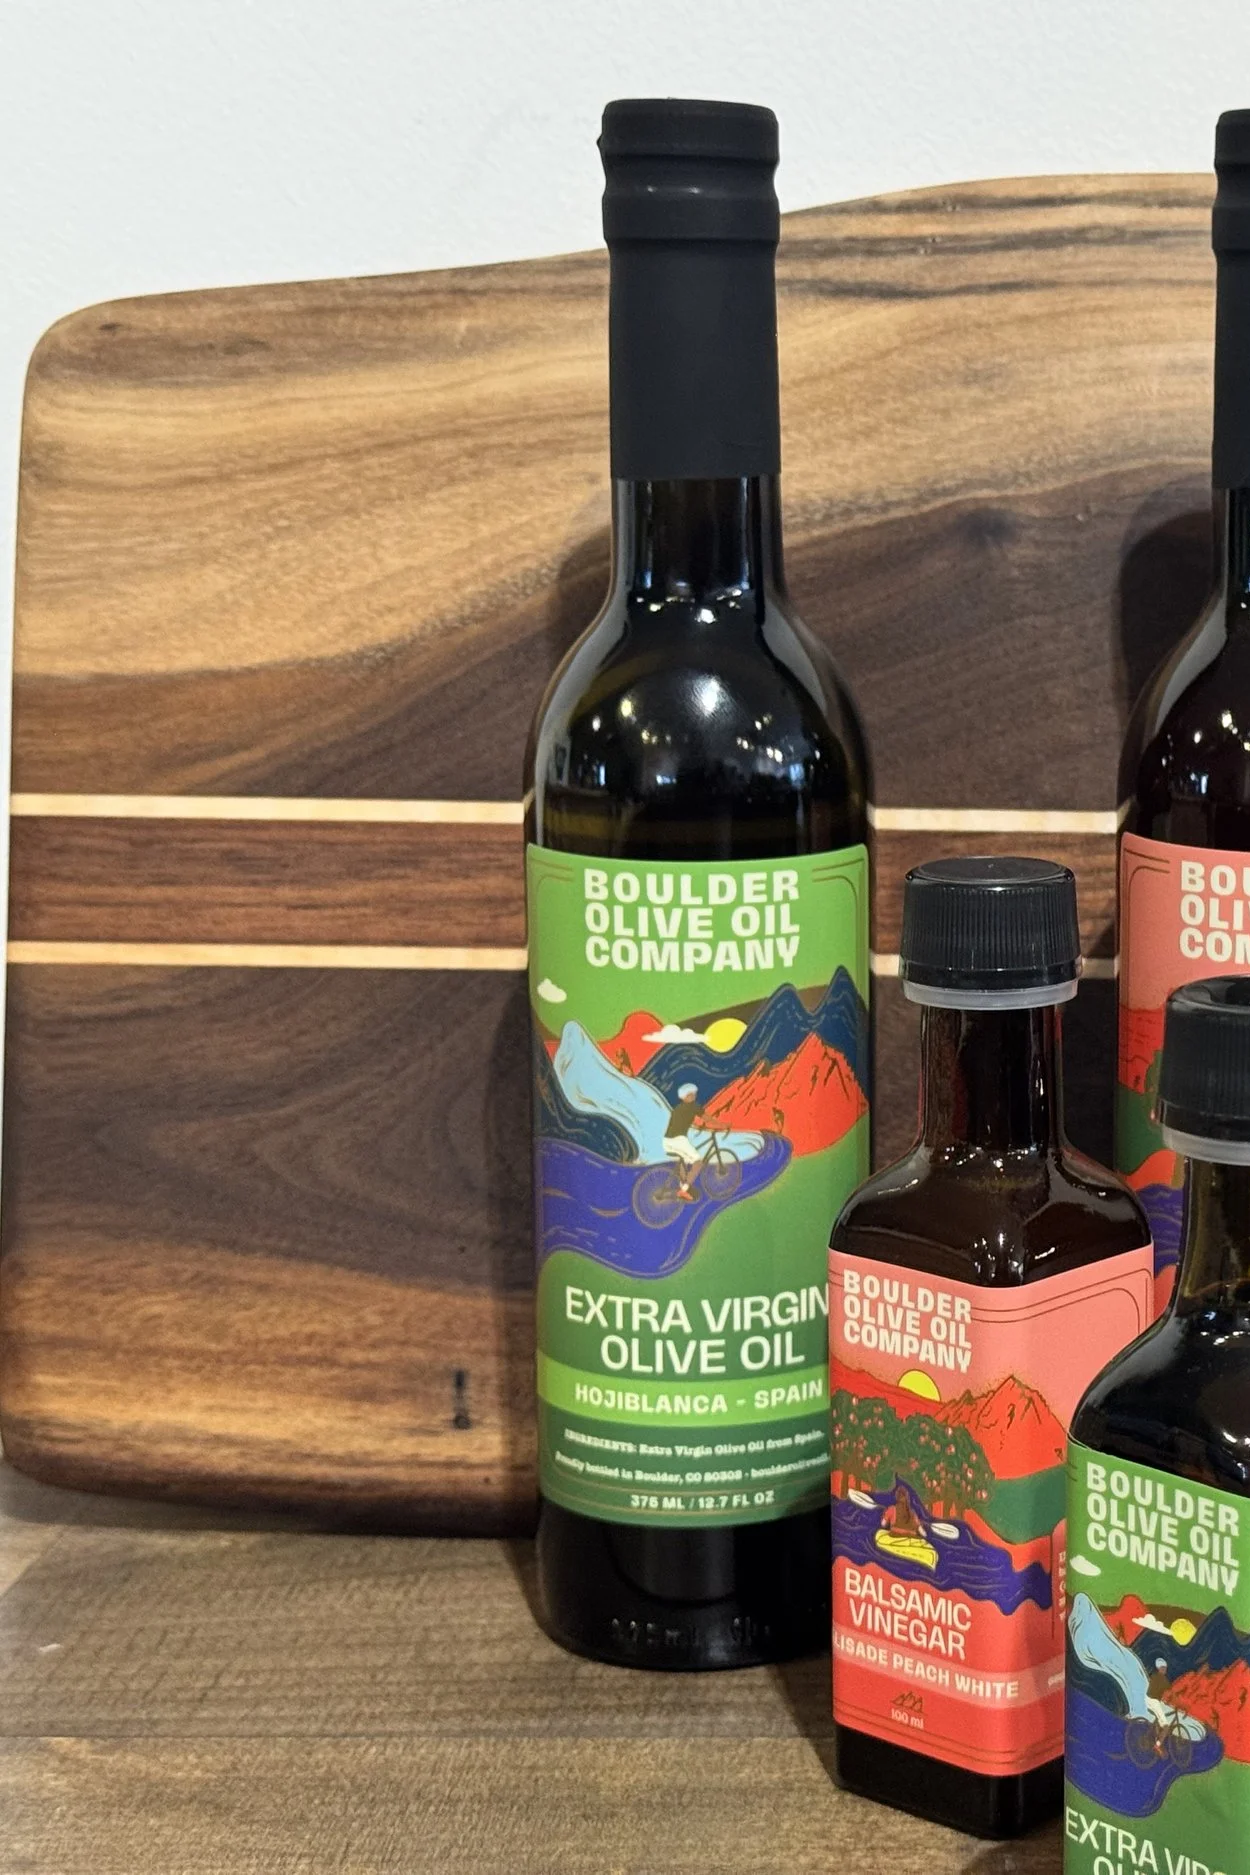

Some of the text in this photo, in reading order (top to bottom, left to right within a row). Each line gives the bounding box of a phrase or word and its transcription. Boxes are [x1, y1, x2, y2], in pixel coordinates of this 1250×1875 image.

[584, 868, 799, 905] BOULDER
[585, 902, 799, 939] OLIVE OIL
[585, 935, 800, 972] COMPANY
[565, 1283, 829, 1333] EXTRA VIRGIN
[843, 1269, 972, 1323] BOULDER
[843, 1294, 972, 1349] OLIVE OIL
[843, 1319, 972, 1374] COMPANY
[600, 1331, 805, 1374] OLIVE OIL
[575, 1382, 727, 1414] HOJIBLANCA
[754, 1378, 823, 1409] SPAIN
[639, 1443, 672, 1457] Extra
[674, 1445, 712, 1458] Virgin
[714, 1443, 746, 1455] Olive
[747, 1440, 764, 1453] Oil
[766, 1437, 792, 1450] from
[630, 1495, 658, 1509] 375
[662, 1496, 685, 1509] ML
[698, 1495, 728, 1509] 12.7
[732, 1494, 750, 1507] FL
[754, 1489, 775, 1505] OZ
[1086, 1461, 1240, 1537] BOULDER
[1087, 1492, 1240, 1568] OLIVE OIL
[1086, 1526, 1239, 1597] COMPANY
[844, 1567, 972, 1631] BALSAMIC
[849, 1598, 966, 1661] VINEGAR
[893, 1653, 950, 1686] PEACH
[955, 1672, 1019, 1699] WHITE
[891, 1707, 924, 1730] 100 ml
[1065, 1806, 1159, 1874] EXTRA
